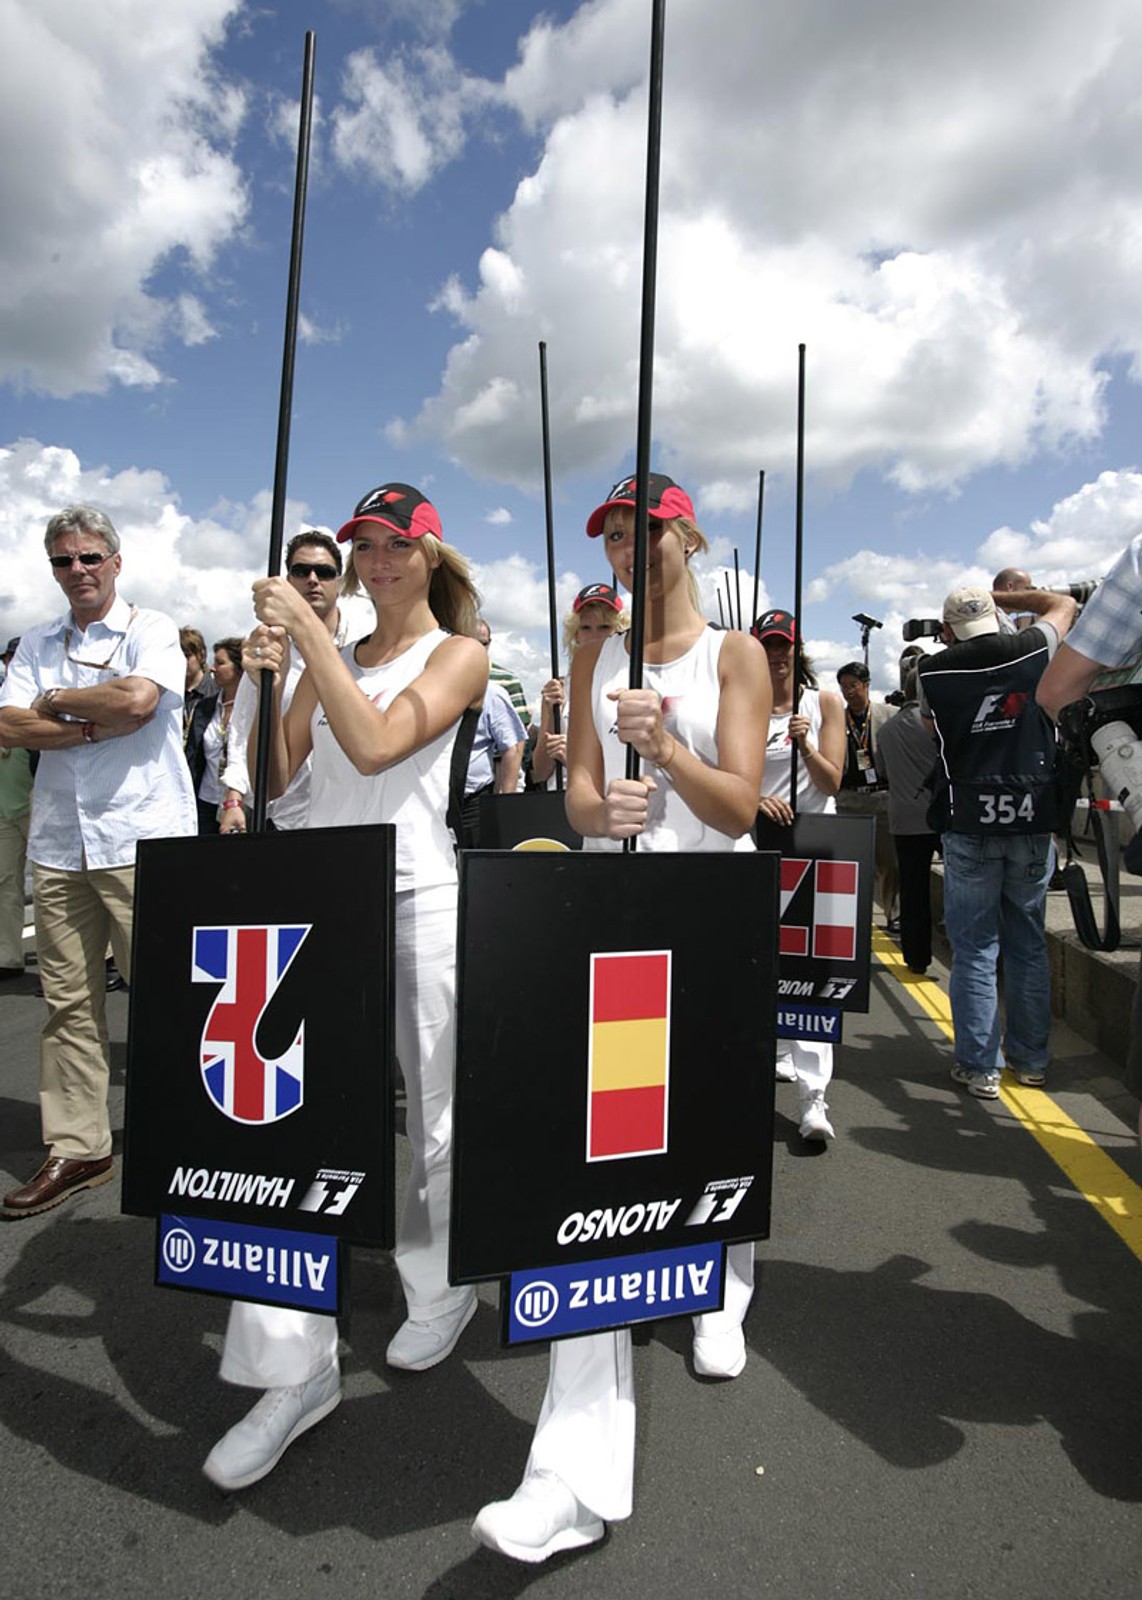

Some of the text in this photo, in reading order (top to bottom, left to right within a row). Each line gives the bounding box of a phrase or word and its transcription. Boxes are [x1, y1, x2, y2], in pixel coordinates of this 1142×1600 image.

[979, 793, 1035, 824] 354
[777, 979, 815, 996] WUR
[191, 923, 313, 1125] 2
[586, 949, 672, 1163] 1
[168, 1166, 296, 1208] HAMILTON
[298, 1181, 359, 1215] F1
[684, 1188, 748, 1226] F1
[557, 1199, 682, 1246] ALONSO
[203, 1238, 330, 1292] Allianz
[569, 1260, 714, 1309] Allianz
